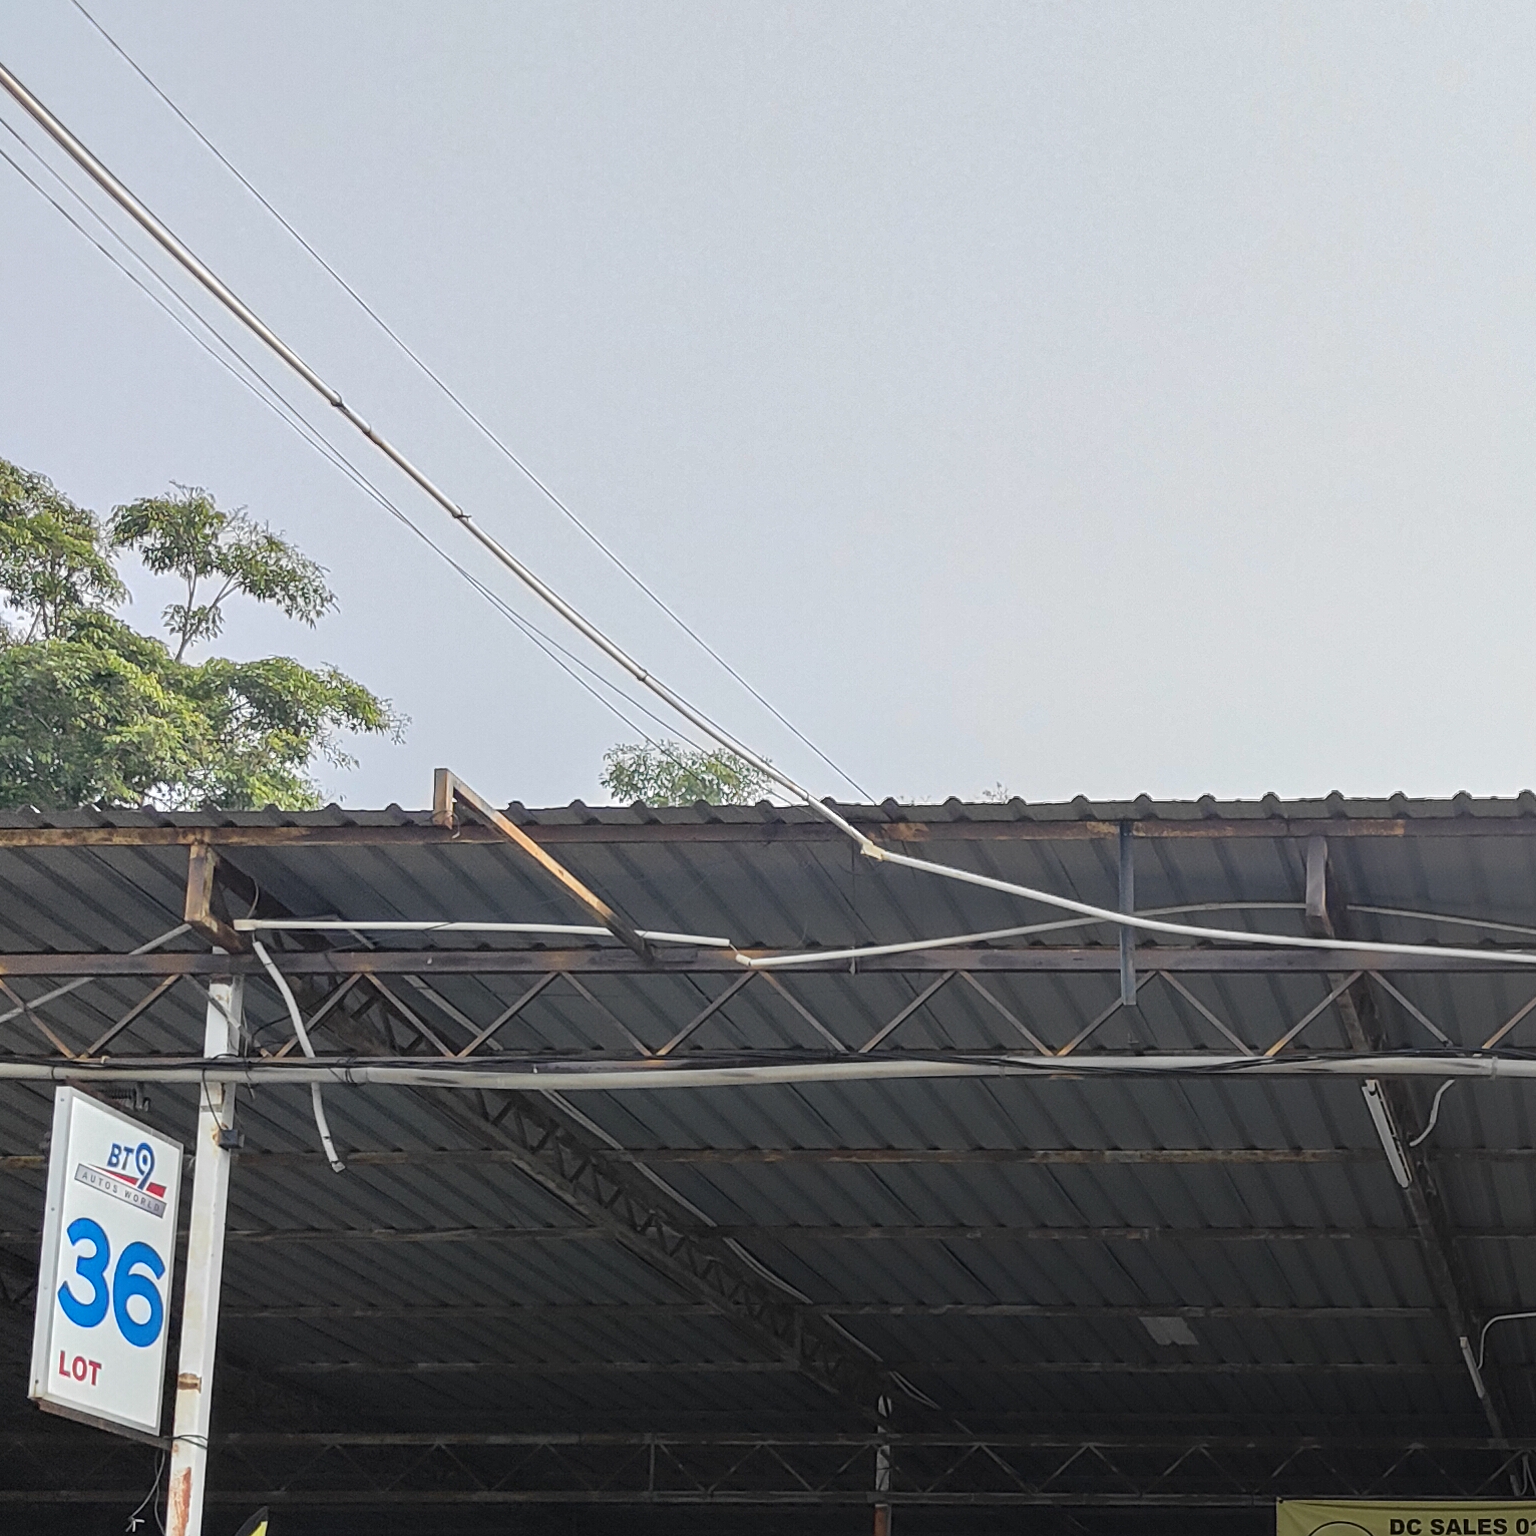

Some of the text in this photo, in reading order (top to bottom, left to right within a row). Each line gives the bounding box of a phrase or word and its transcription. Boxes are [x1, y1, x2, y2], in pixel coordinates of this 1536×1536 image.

[81, 1171, 161, 1212] AUTOS WORLD
[57, 1217, 165, 1348] 36
[59, 1350, 102, 1386] LOT
[1389, 1519, 1423, 1535] DC
[1430, 1518, 1508, 1535] SALES
